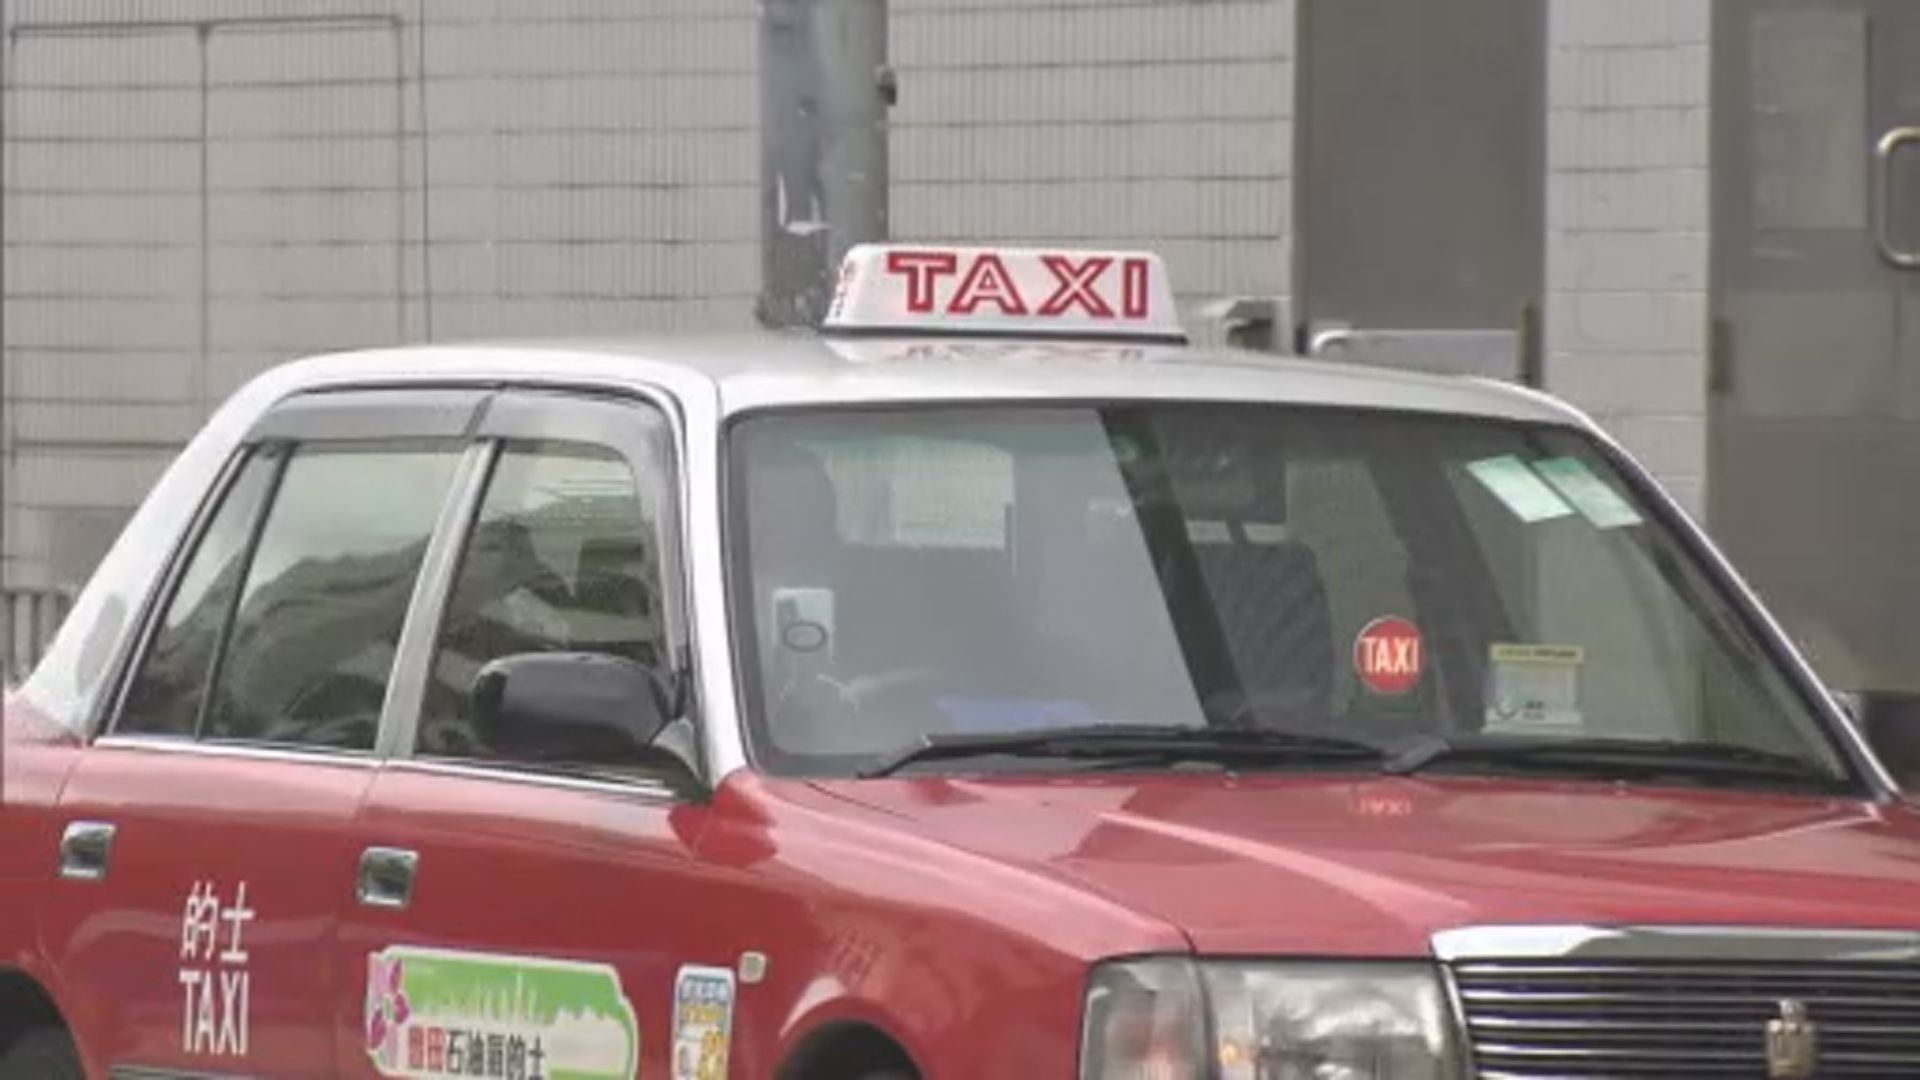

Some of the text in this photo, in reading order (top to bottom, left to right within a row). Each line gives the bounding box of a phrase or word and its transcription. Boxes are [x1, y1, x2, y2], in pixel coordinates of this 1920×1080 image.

[886, 251, 1149, 318] TAXI
[1361, 636, 1419, 674] TAXI
[180, 880, 256, 962] 的士
[179, 969, 249, 1056] TAXI
